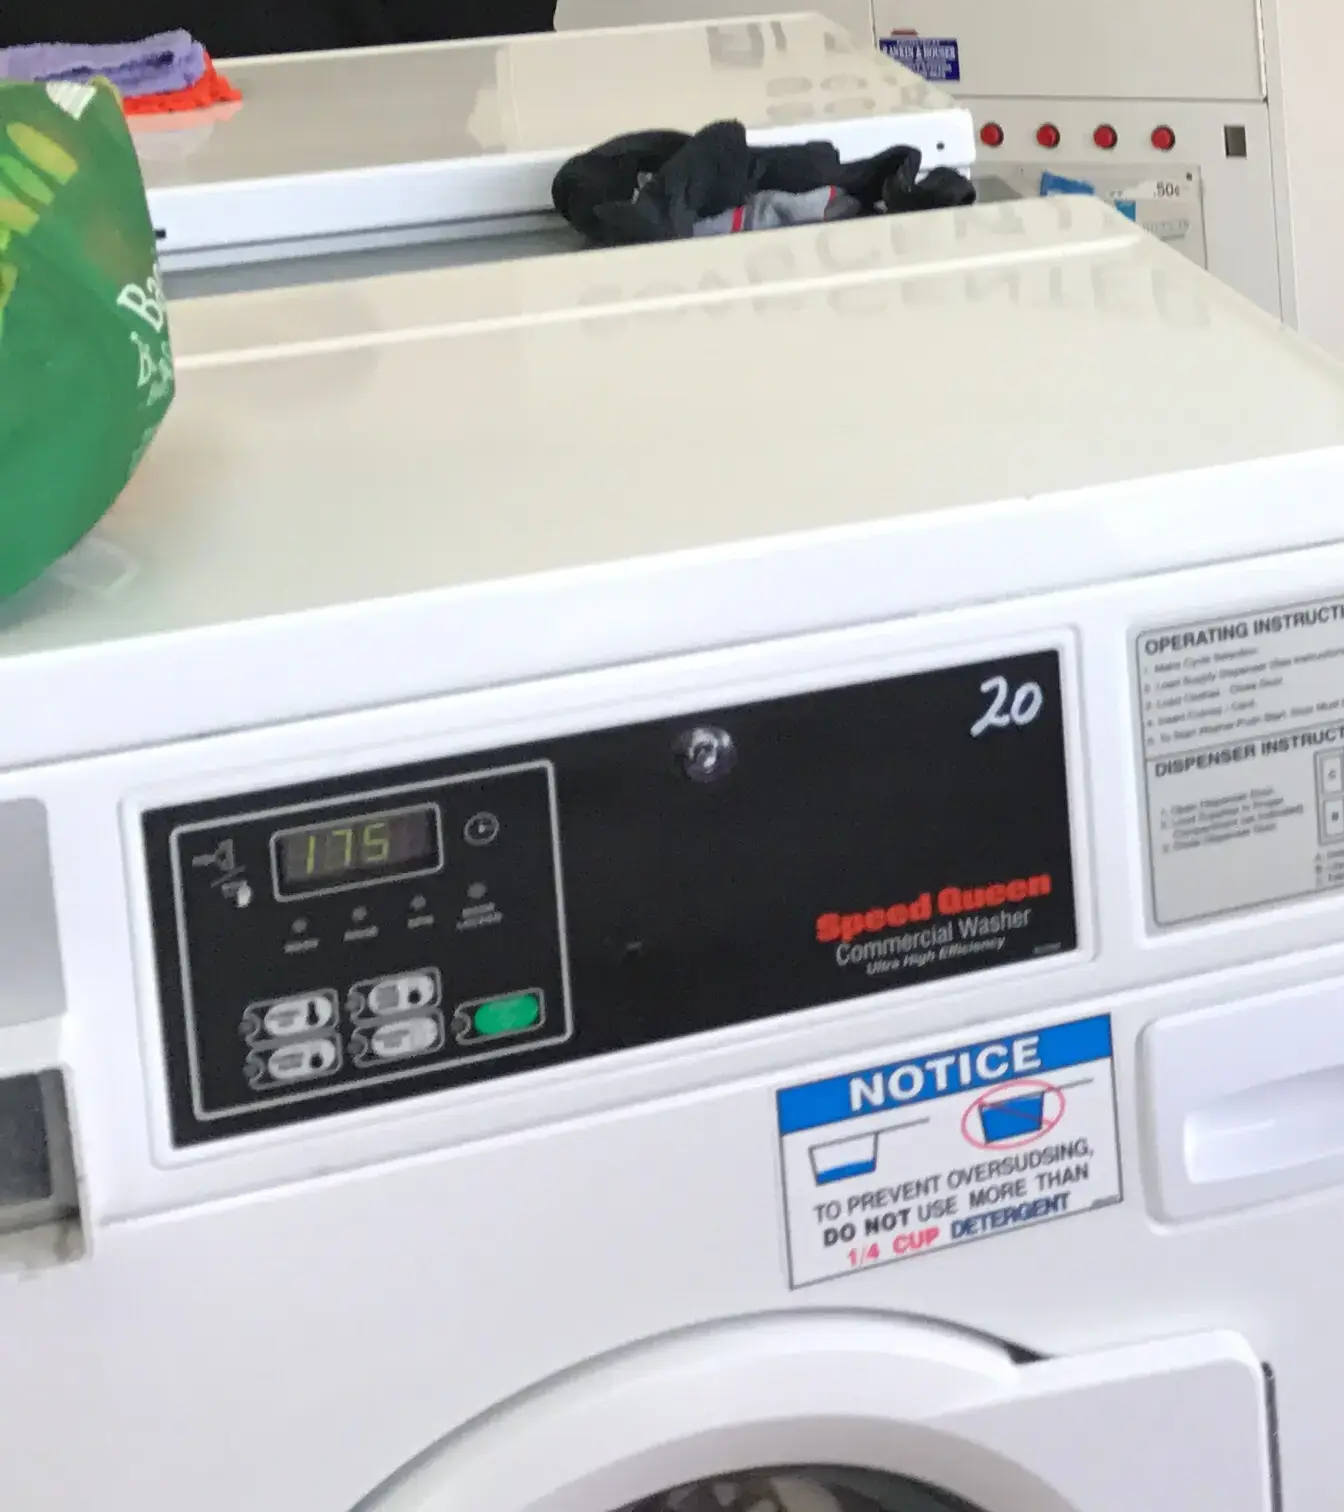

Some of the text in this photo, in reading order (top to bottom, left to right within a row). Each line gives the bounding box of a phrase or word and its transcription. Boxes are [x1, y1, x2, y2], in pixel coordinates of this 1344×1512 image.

[1144, 622, 1250, 656] OPERATING
[970, 675, 1043, 738] 20
[1154, 744, 1257, 777] DISPENSER
[305, 821, 390, 875] 175
[815, 873, 1052, 943] Speed Queen
[835, 908, 1032, 966] Commercial Washer
[866, 937, 1006, 976] Ultra High Efficiency
[849, 1035, 1042, 1113] NOTICE
[813, 1137, 1095, 1224] TO PREVENT OVERSUDSING,
[823, 1162, 1090, 1248] DO NOT USE MORE THAN
[847, 1192, 1071, 1267] 1/4 CUP DETERGENT
